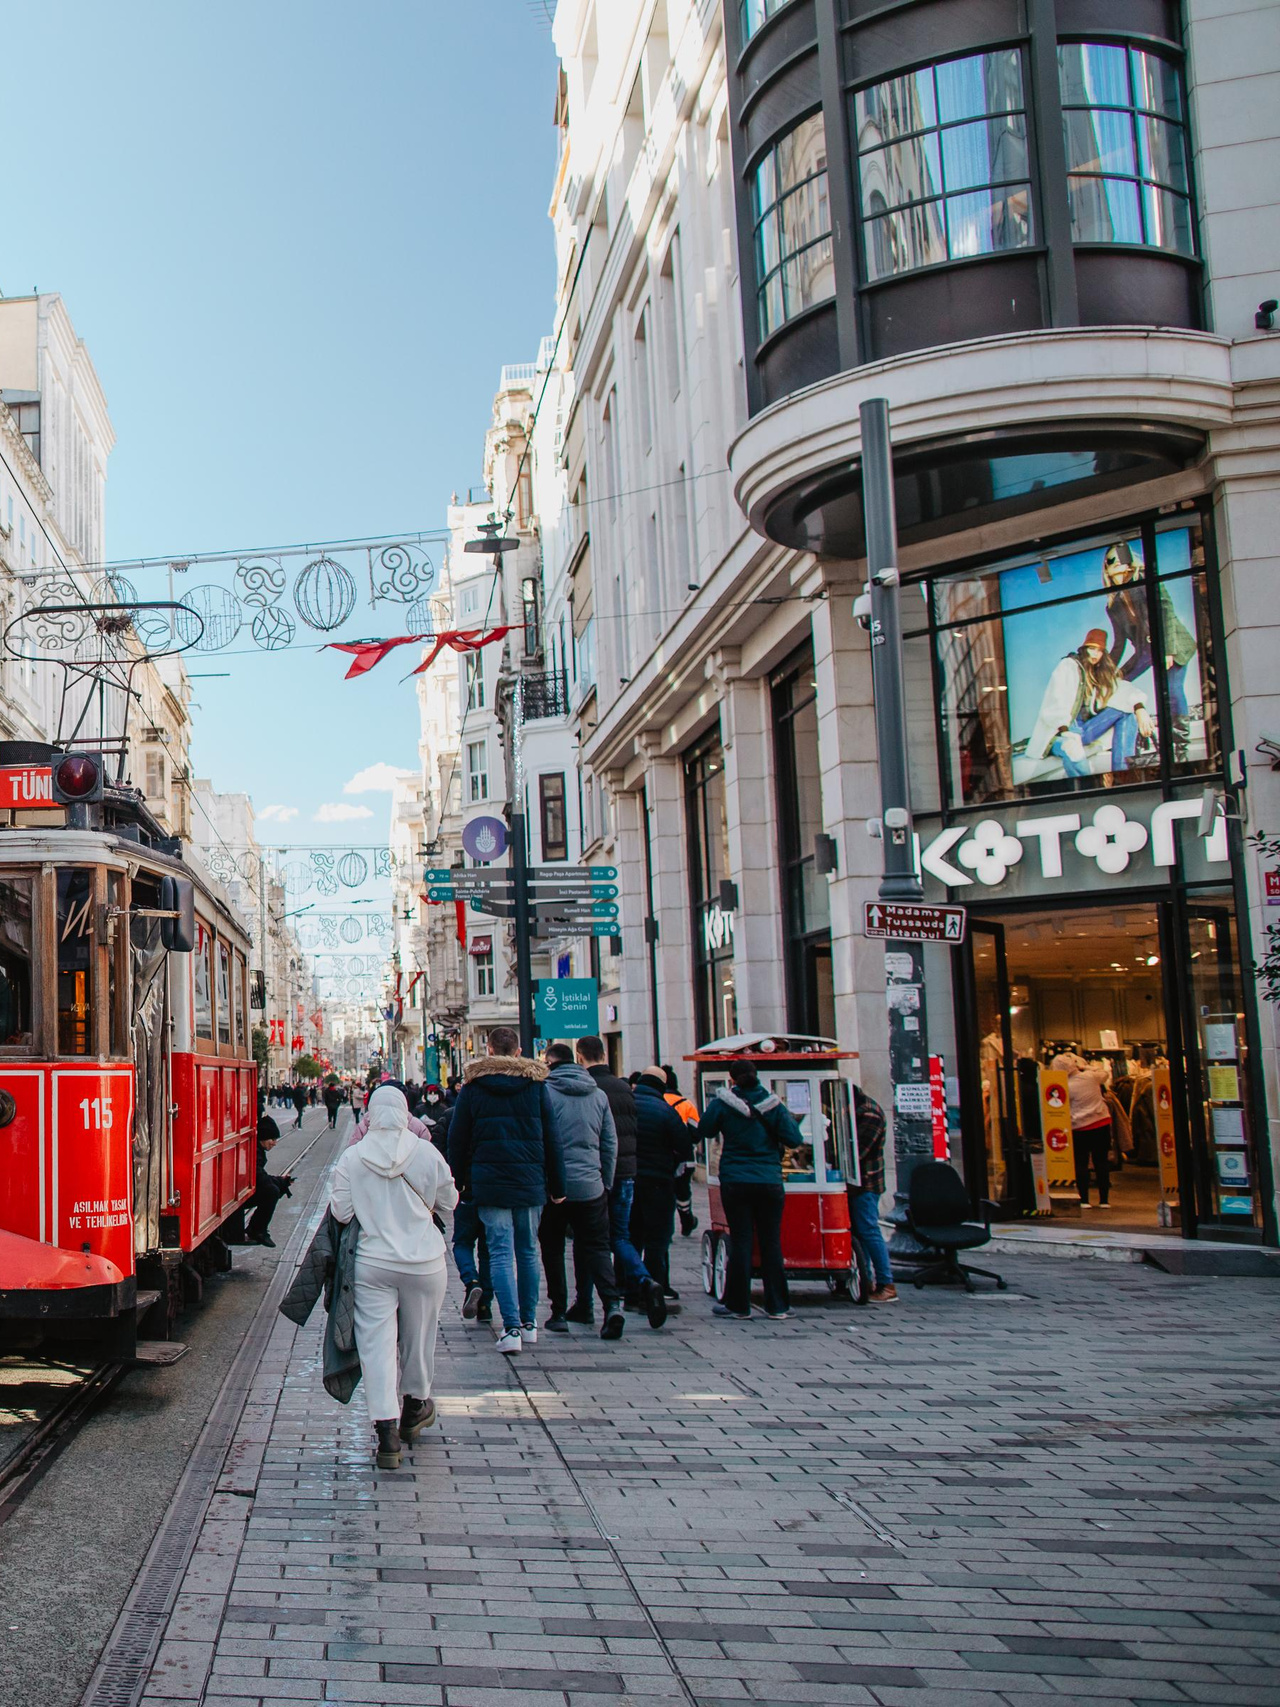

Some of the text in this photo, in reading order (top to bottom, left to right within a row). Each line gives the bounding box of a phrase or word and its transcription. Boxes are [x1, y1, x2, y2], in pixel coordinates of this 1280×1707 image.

[9, 770, 53, 801] TÜN
[886, 906, 941, 918] Madame
[886, 916, 945, 929] Tussauds
[886, 926, 941, 939] İstanbul
[561, 992, 591, 1002] İstiklal
[562, 1002, 588, 1011] Senin
[79, 1098, 113, 1130] 115
[73, 1198, 127, 1213] ASILMAK YASAK
[69, 1216, 81, 1229] VE
